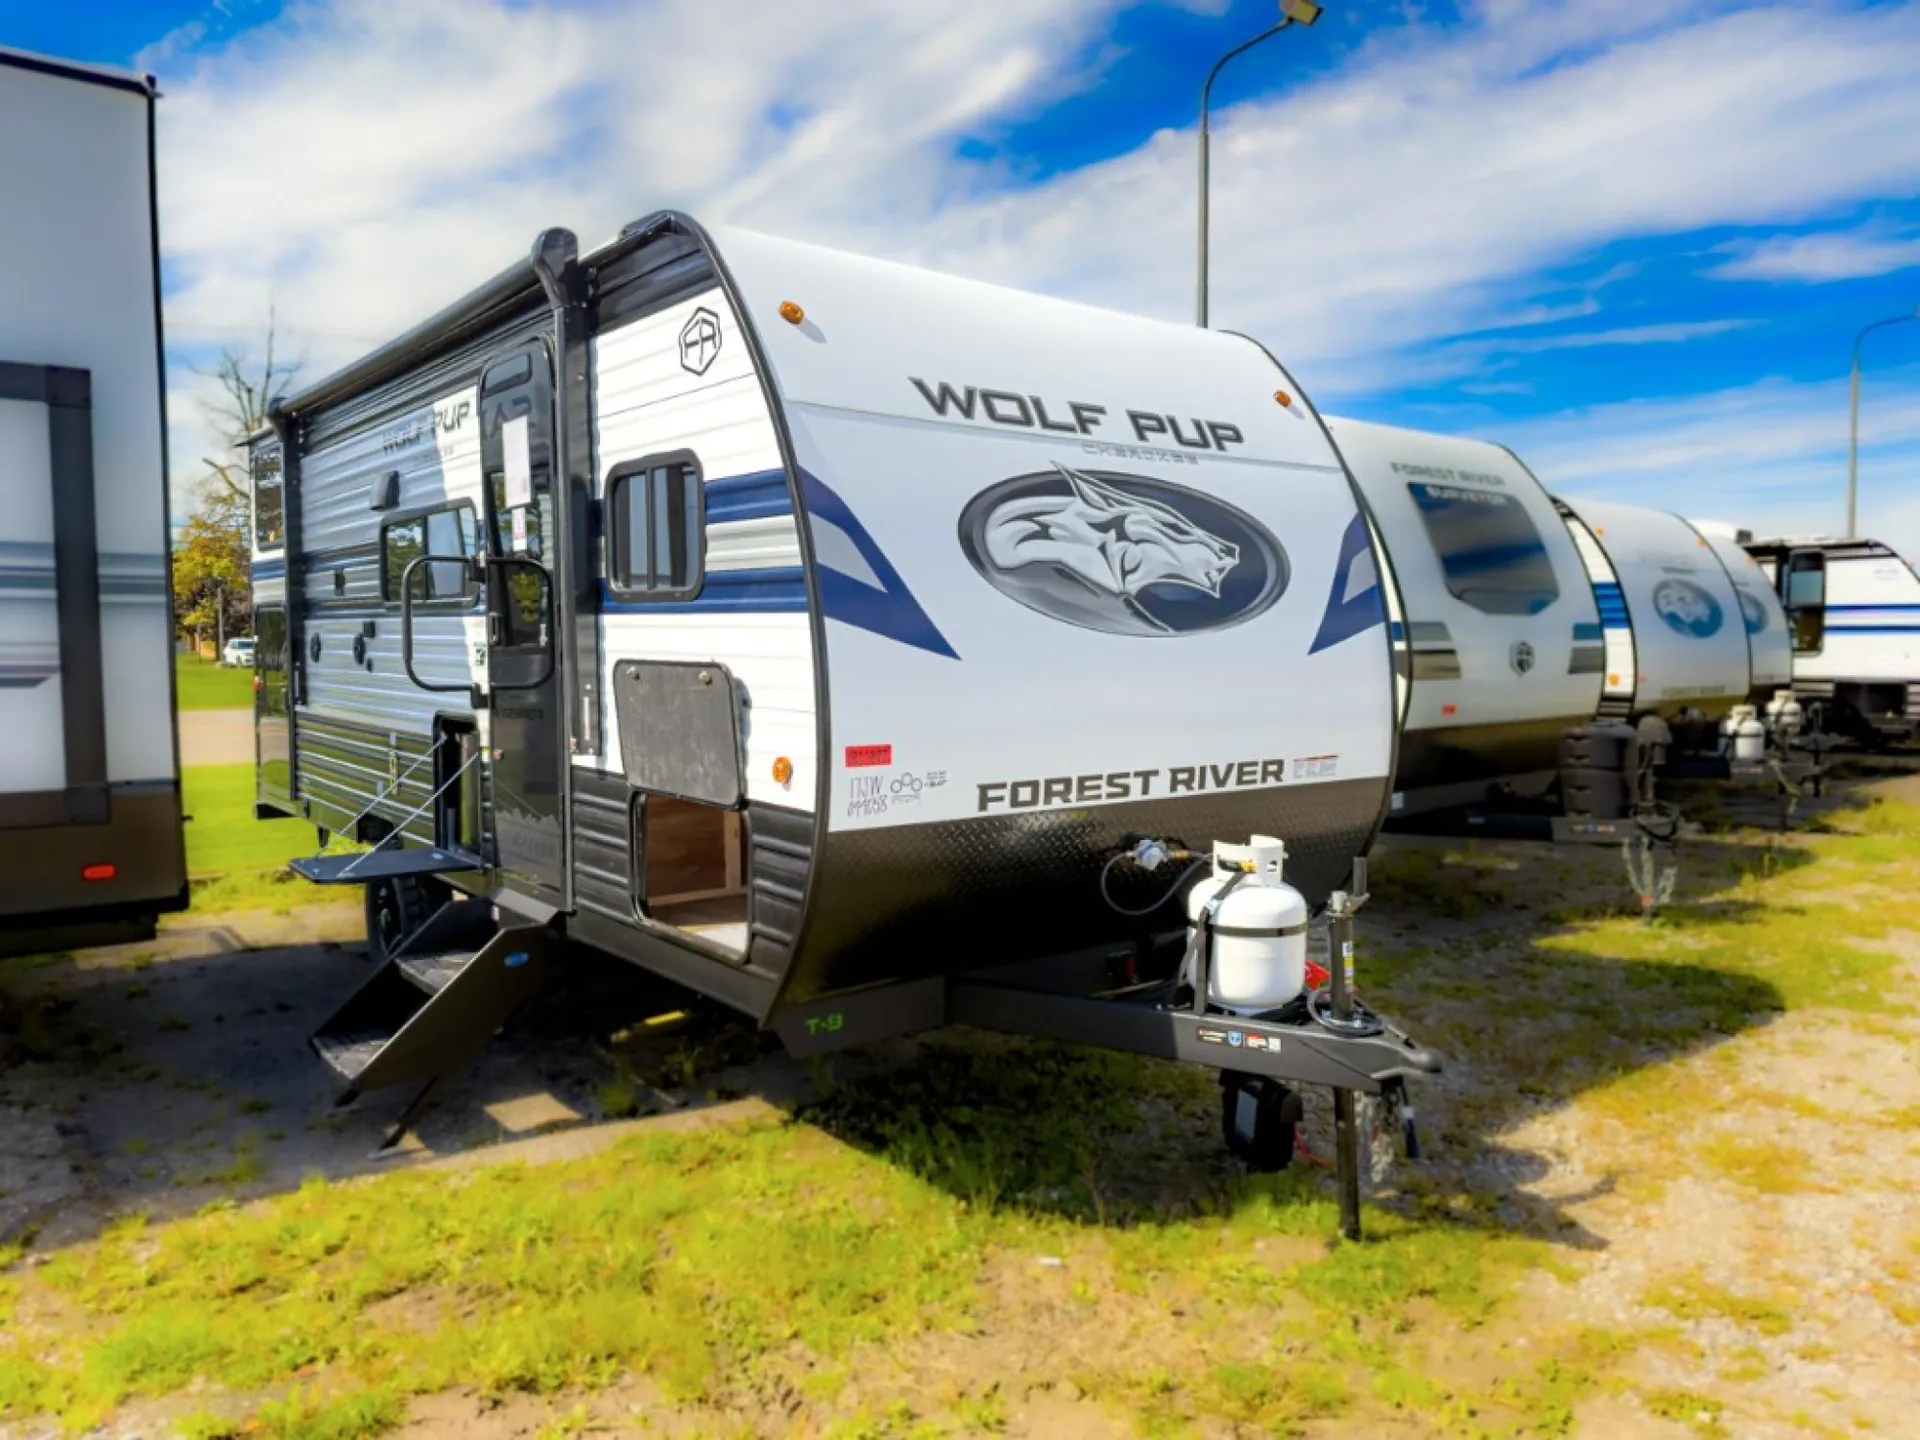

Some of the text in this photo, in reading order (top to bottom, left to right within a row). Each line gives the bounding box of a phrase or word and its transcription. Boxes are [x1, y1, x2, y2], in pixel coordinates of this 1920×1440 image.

[906, 376, 1244, 451] WOLF PUP
[976, 769, 1159, 812] FOREST
[1168, 759, 1285, 794] RIVER
